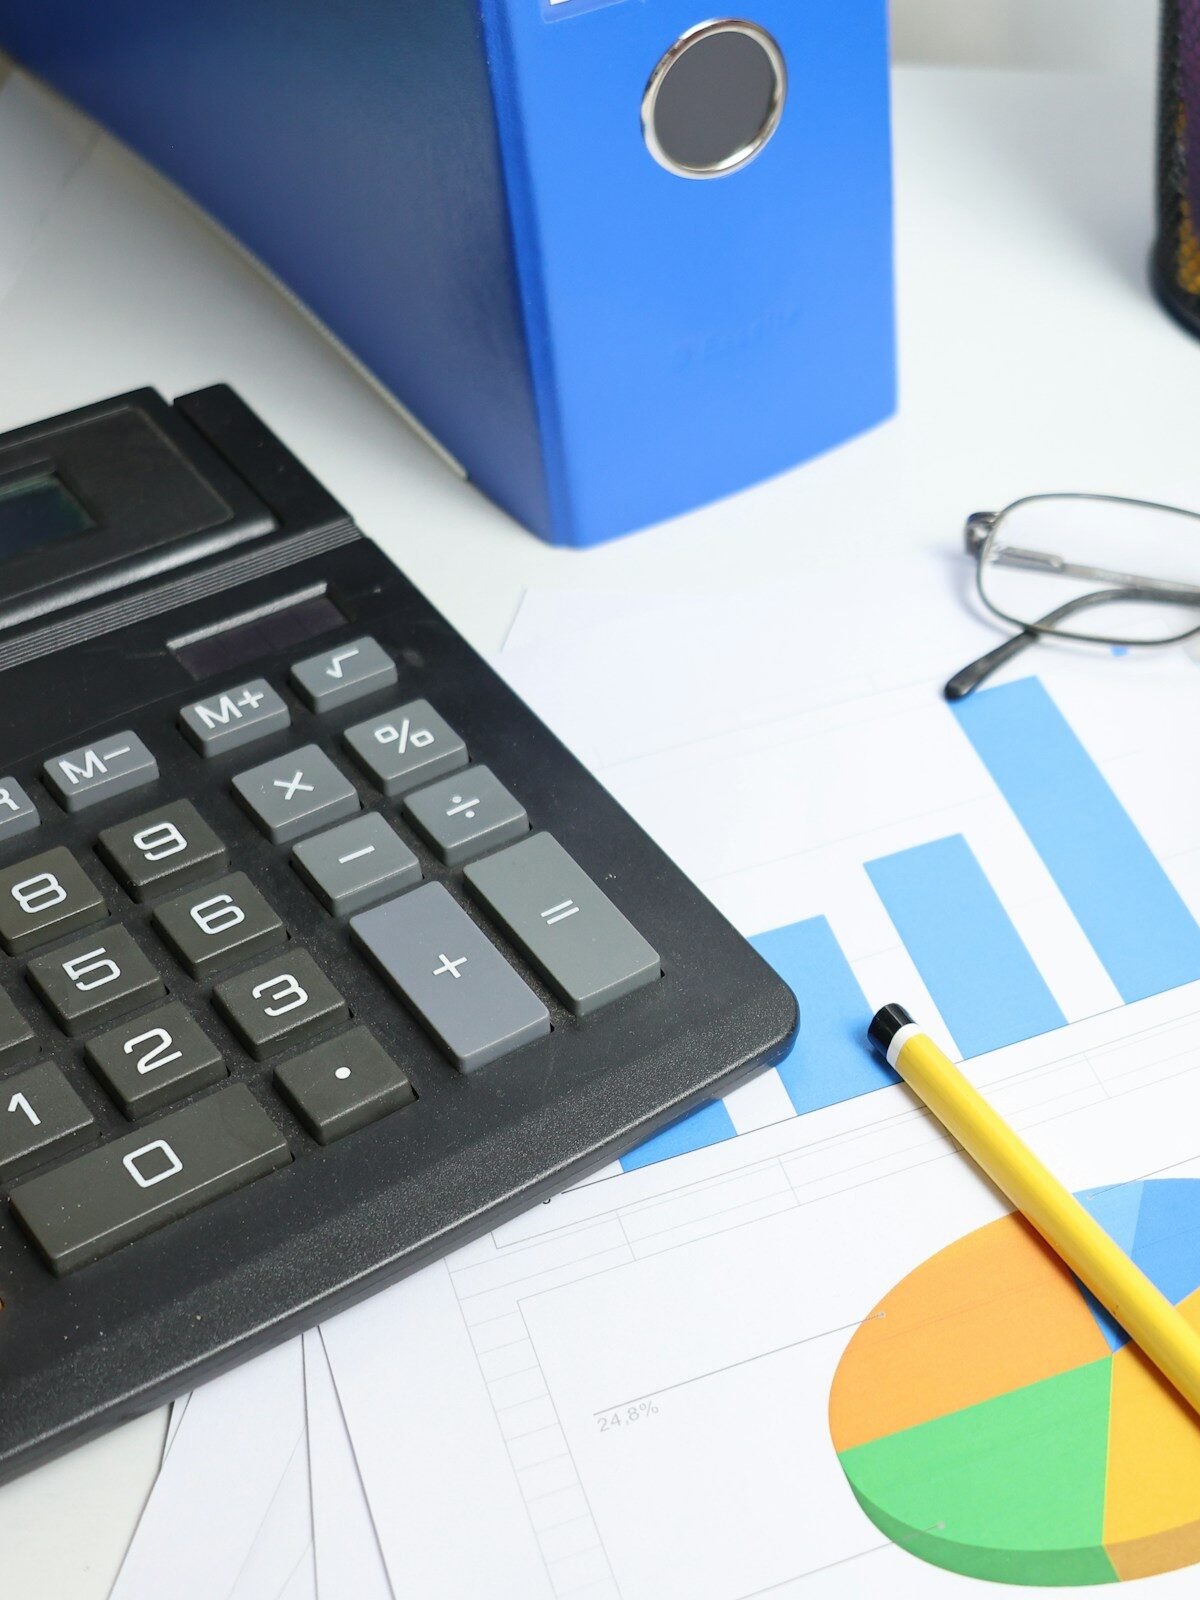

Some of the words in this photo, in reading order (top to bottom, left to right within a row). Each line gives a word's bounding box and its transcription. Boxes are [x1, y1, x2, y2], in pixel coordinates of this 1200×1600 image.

[193, 688, 265, 731] M+
[373, 717, 435, 755] %
[132, 821, 189, 862] 9
[10, 872, 68, 915] 8
[189, 893, 246, 936] 6
[539, 898, 581, 926] =
[61, 946, 122, 992] 5
[431, 952, 469, 981] +
[251, 972, 309, 1018] 3
[123, 1027, 183, 1075] 2
[7, 1091, 42, 1127] 1
[122, 1138, 184, 1189] 0
[596, 1399, 660, 1433] 24,8%
